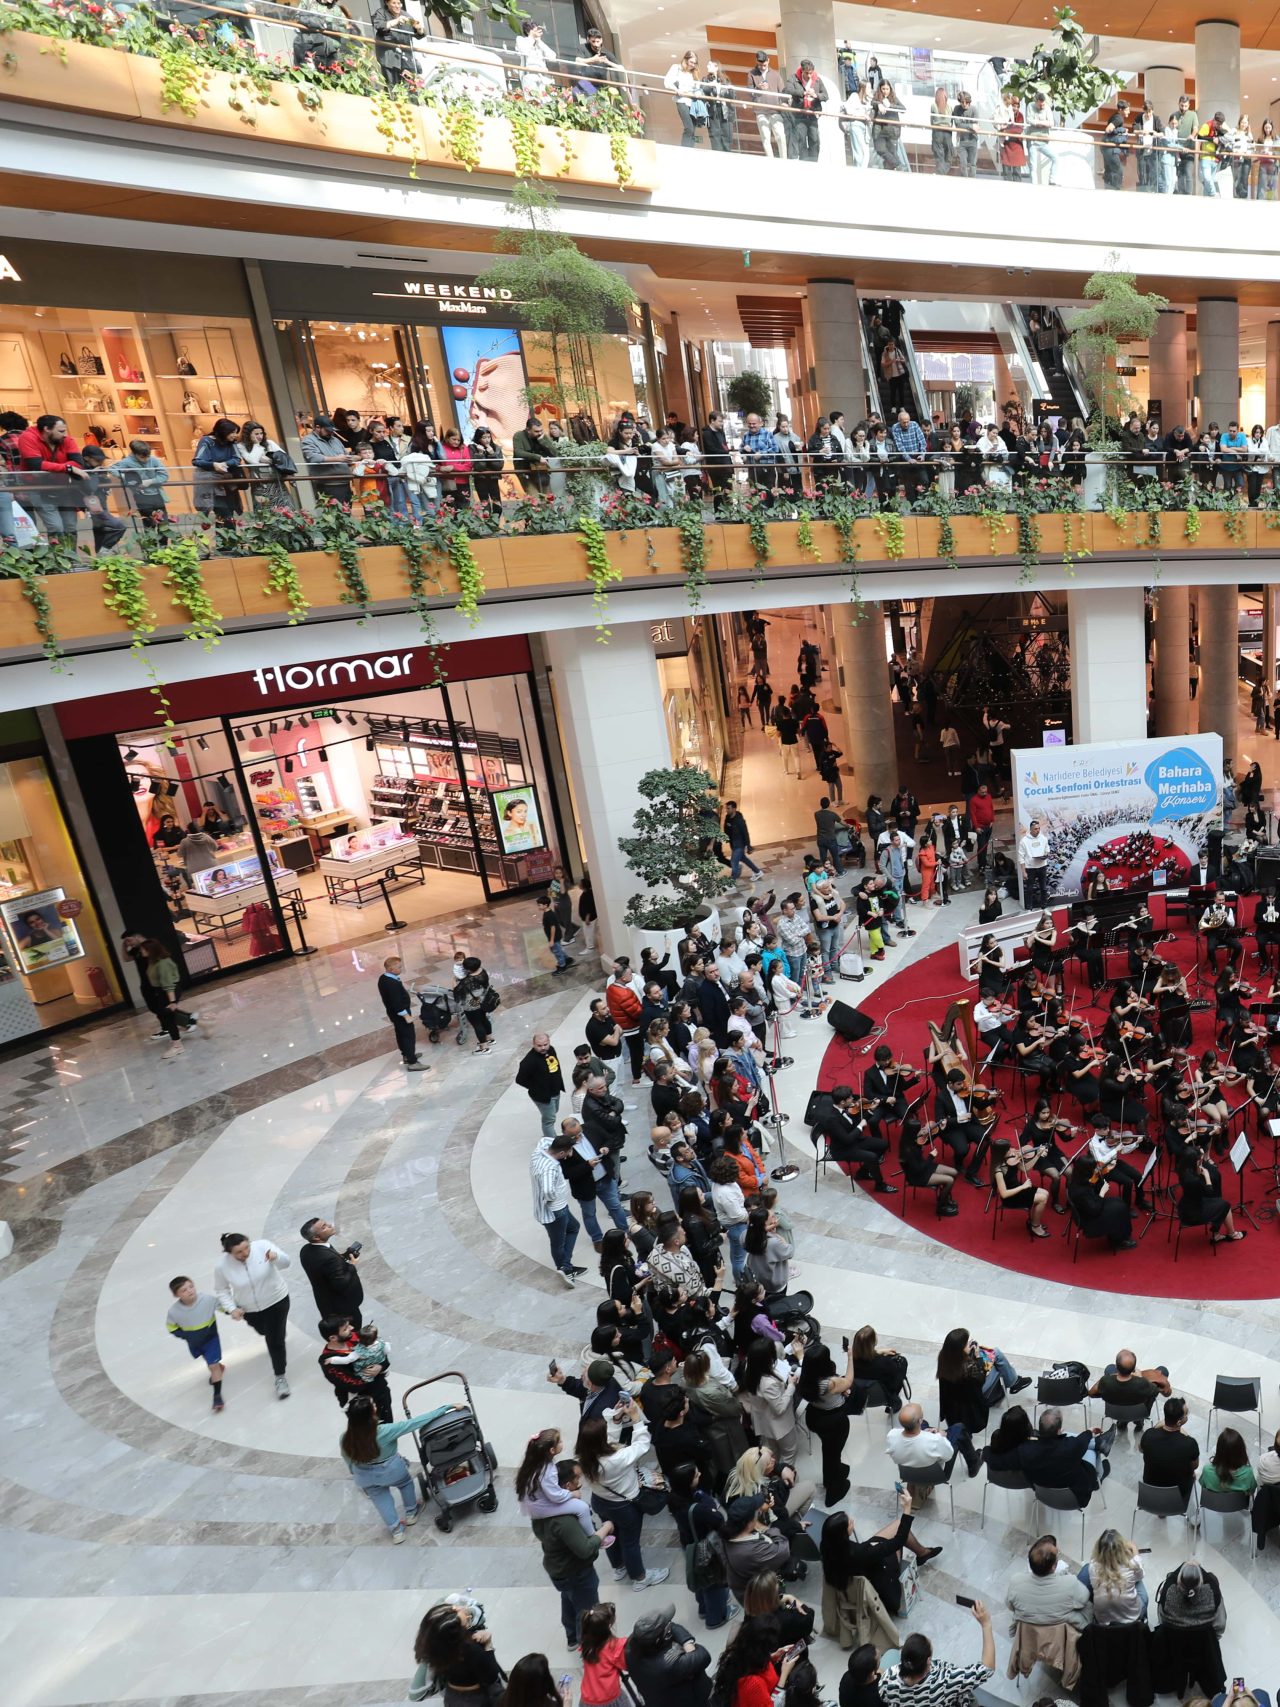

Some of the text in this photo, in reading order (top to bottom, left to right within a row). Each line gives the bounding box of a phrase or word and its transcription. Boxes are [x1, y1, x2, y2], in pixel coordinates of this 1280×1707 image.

[404, 282, 513, 300] WEEKEND
[439, 301, 487, 314] MaxMara
[253, 653, 414, 695] flormar
[1083, 767, 1123, 778] Belediyesi
[1158, 766, 1202, 778] Bahara
[1024, 785, 1054, 798] Çocuk
[1056, 781, 1092, 793] Senfoni
[1094, 778, 1142, 789] Orkestrası
[1158, 781, 1212, 795] Merhaba
[1161, 794, 1207, 808] Konseri
